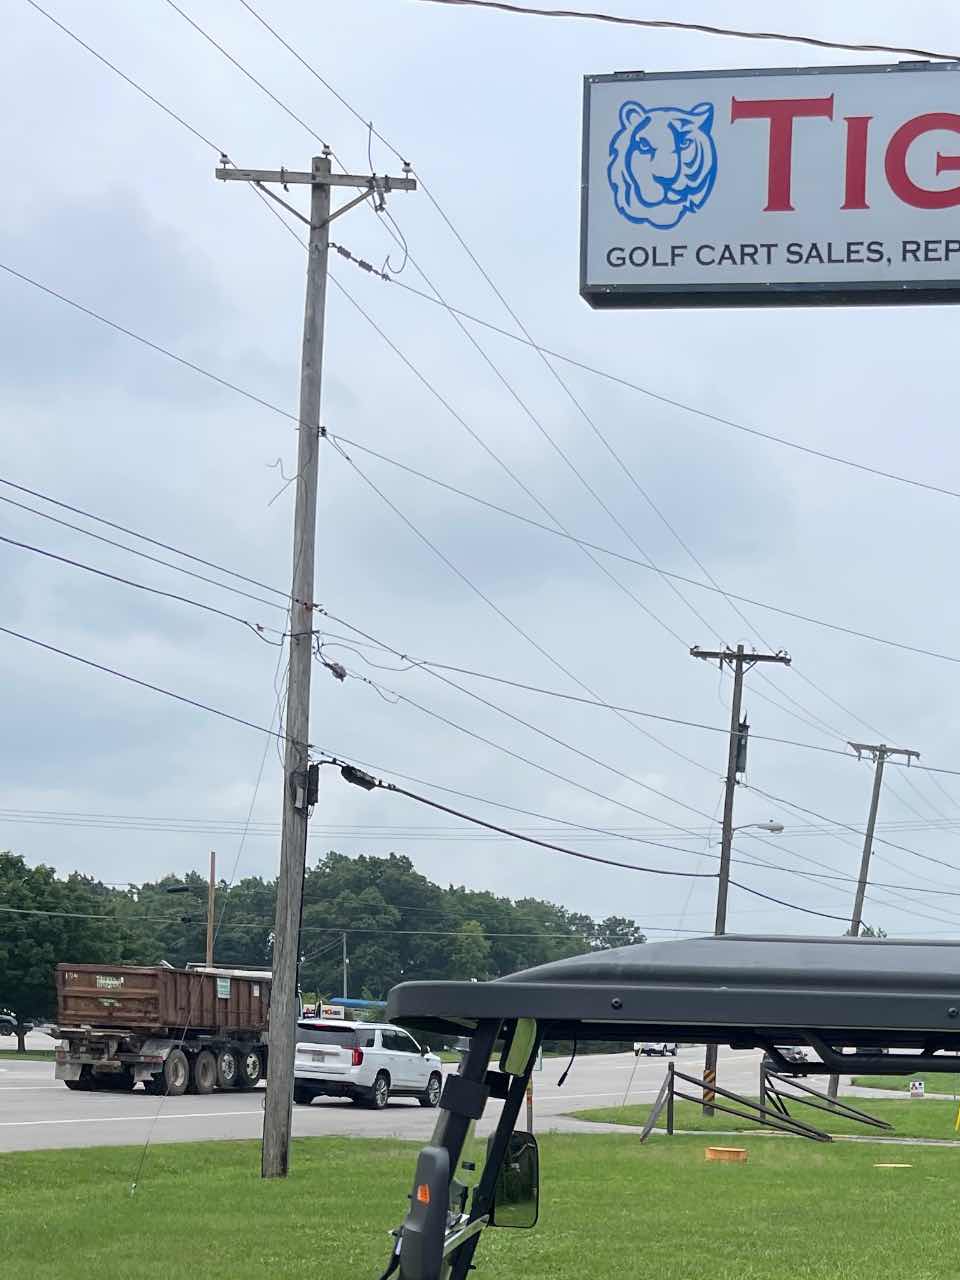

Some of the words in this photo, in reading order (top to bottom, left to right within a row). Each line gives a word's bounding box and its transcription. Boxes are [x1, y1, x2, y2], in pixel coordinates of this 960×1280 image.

[606, 245, 688, 268] GOLF
[695, 243, 779, 266] CART
[786, 241, 893, 266] SALES,
